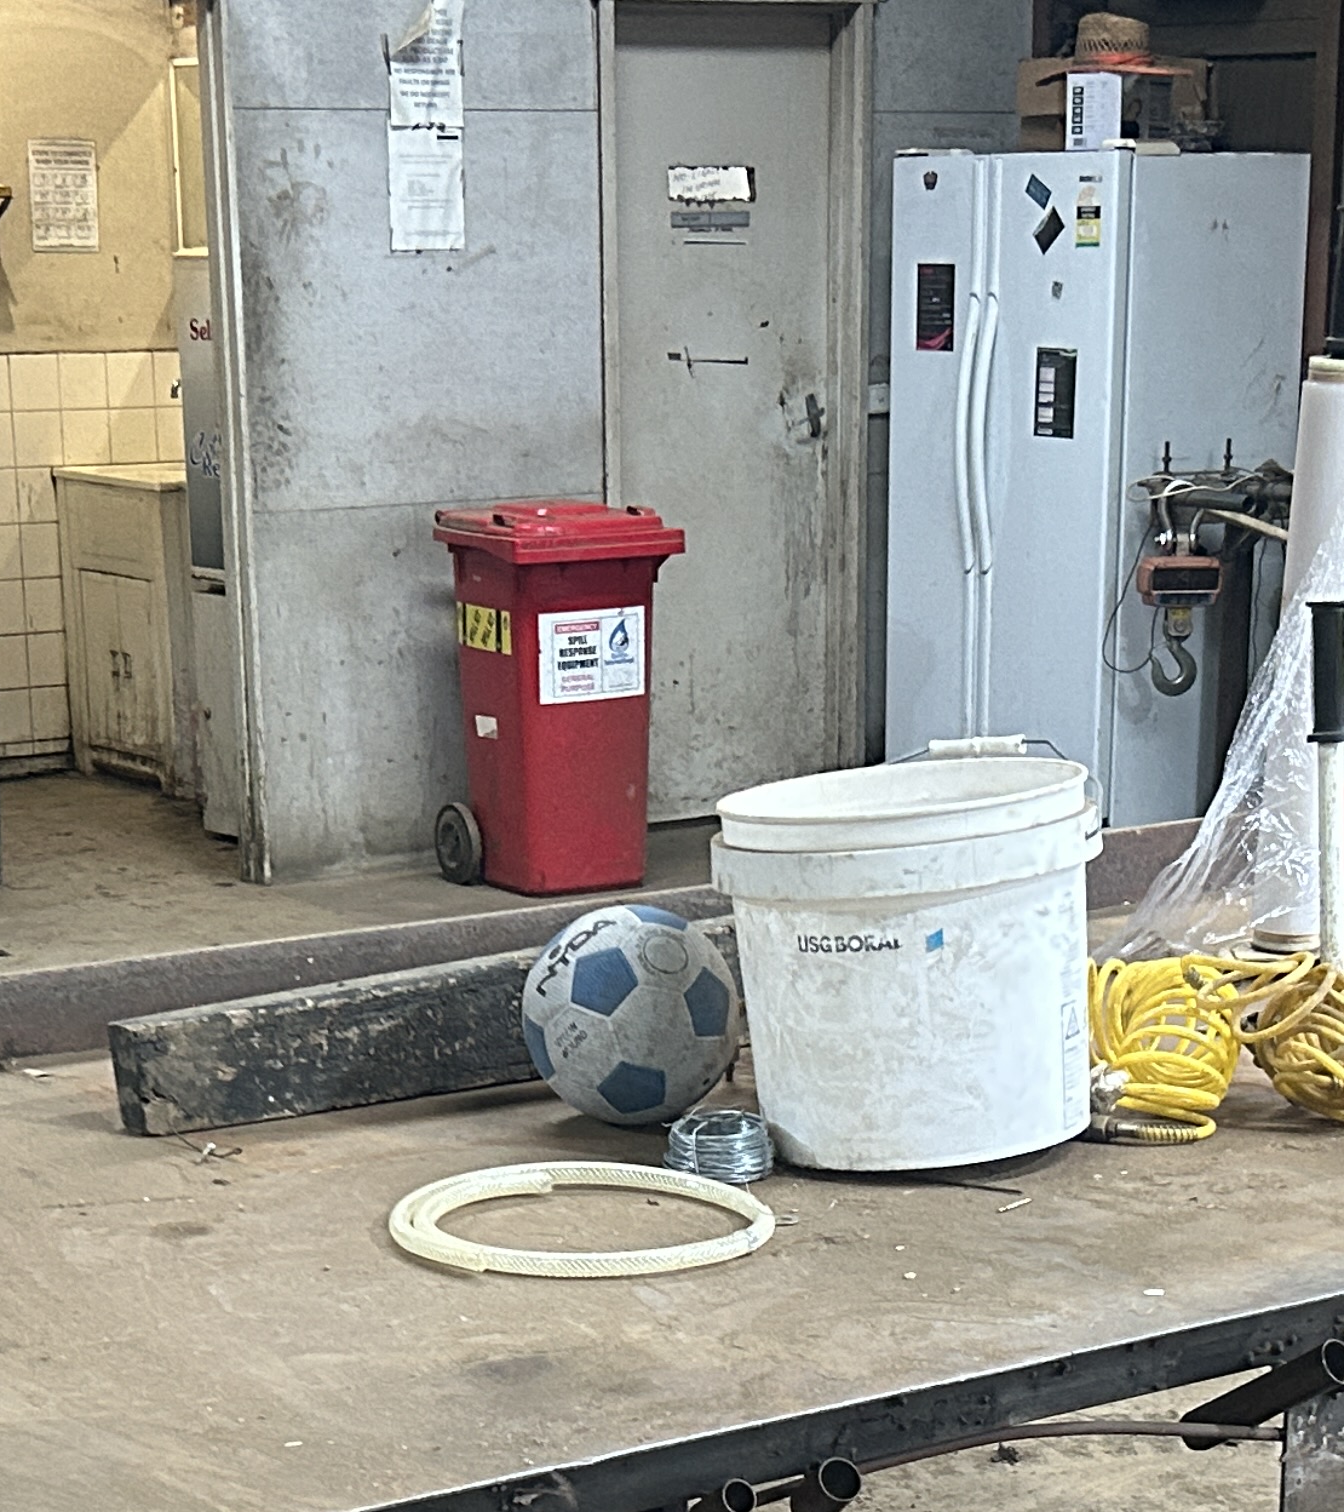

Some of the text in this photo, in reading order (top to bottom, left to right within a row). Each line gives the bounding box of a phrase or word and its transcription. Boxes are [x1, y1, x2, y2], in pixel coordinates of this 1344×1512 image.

[568, 635, 588, 646] SPILL
[558, 646, 597, 658] RESPONSE
[557, 658, 599, 671] EQUIPMENT
[797, 935, 833, 953] USG
